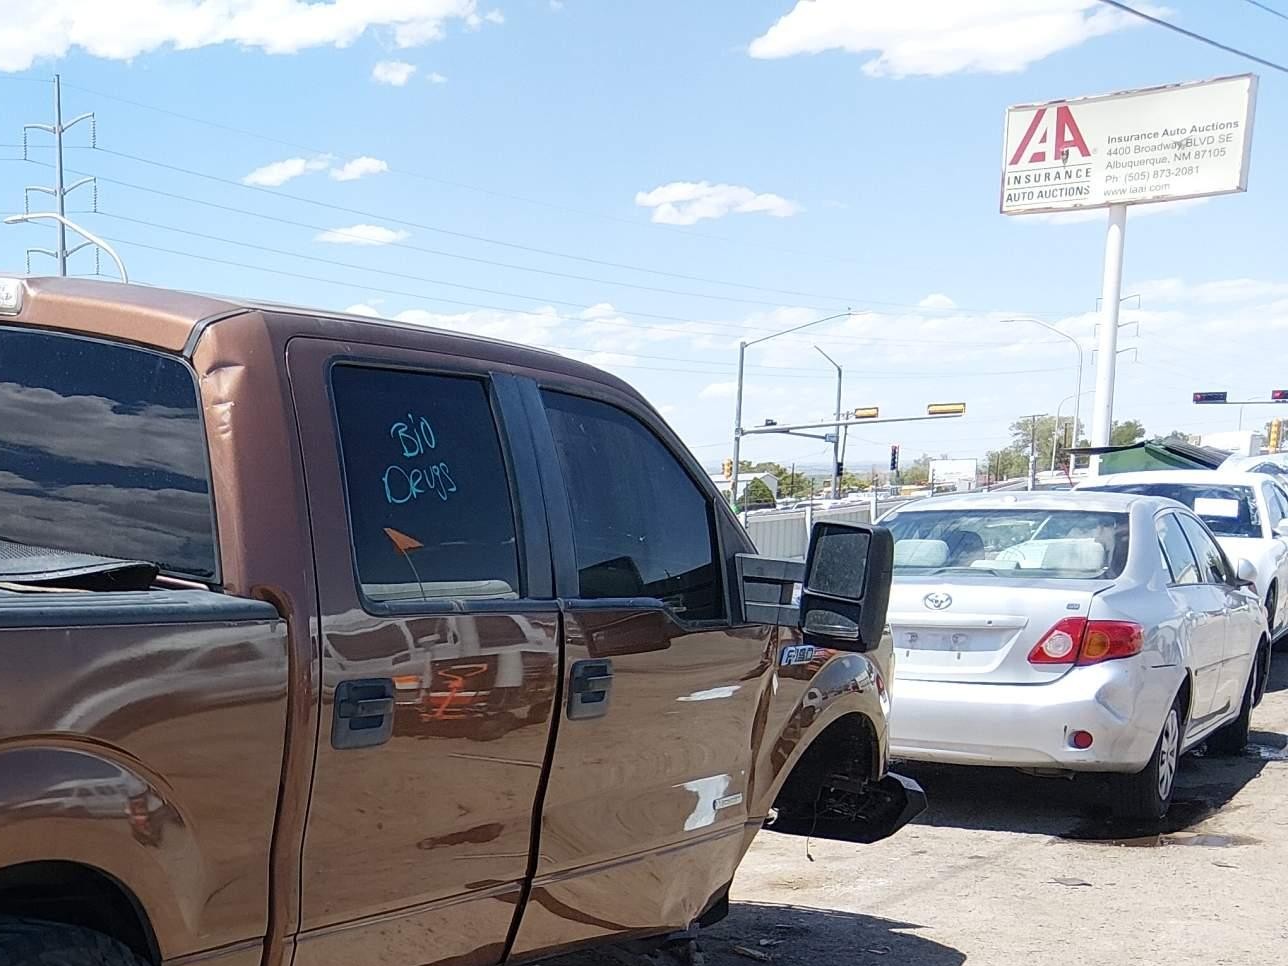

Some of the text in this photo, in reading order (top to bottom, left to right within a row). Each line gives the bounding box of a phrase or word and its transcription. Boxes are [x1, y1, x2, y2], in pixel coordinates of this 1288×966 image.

[1107, 121, 1239, 144] Insurance Auto Auctions
[1106, 146, 1131, 156] 4400
[1185, 135, 1215, 148] BLVD
[1218, 133, 1233, 143] SE
[1174, 151, 1192, 161] NM
[1194, 147, 1226, 160] 87105
[1007, 168, 1092, 185] INSURANCE
[1125, 171, 1150, 184] (505)
[1153, 165, 1200, 179] 873-2081
[1006, 185, 1090, 202] AUTO AUCTIONS
